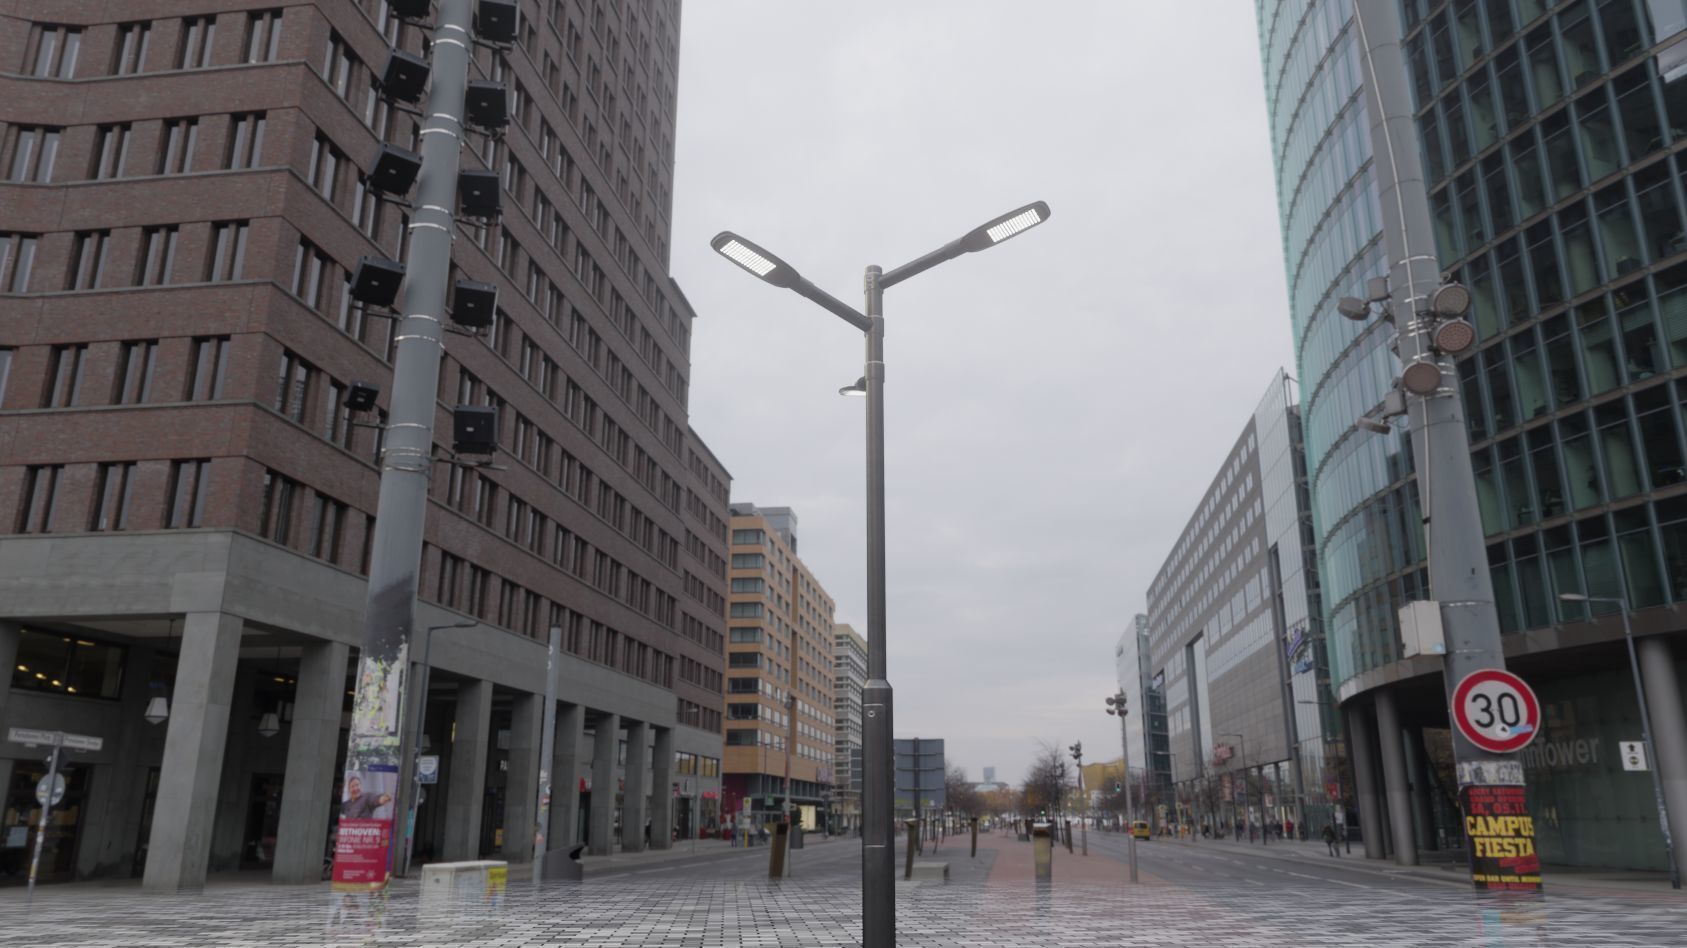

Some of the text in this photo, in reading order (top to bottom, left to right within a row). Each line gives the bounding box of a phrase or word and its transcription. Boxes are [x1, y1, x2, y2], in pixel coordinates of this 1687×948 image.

[1472, 693, 1520, 728] 30
[1465, 816, 1535, 837] CAMPUS
[1474, 837, 1535, 858] FIESTA
